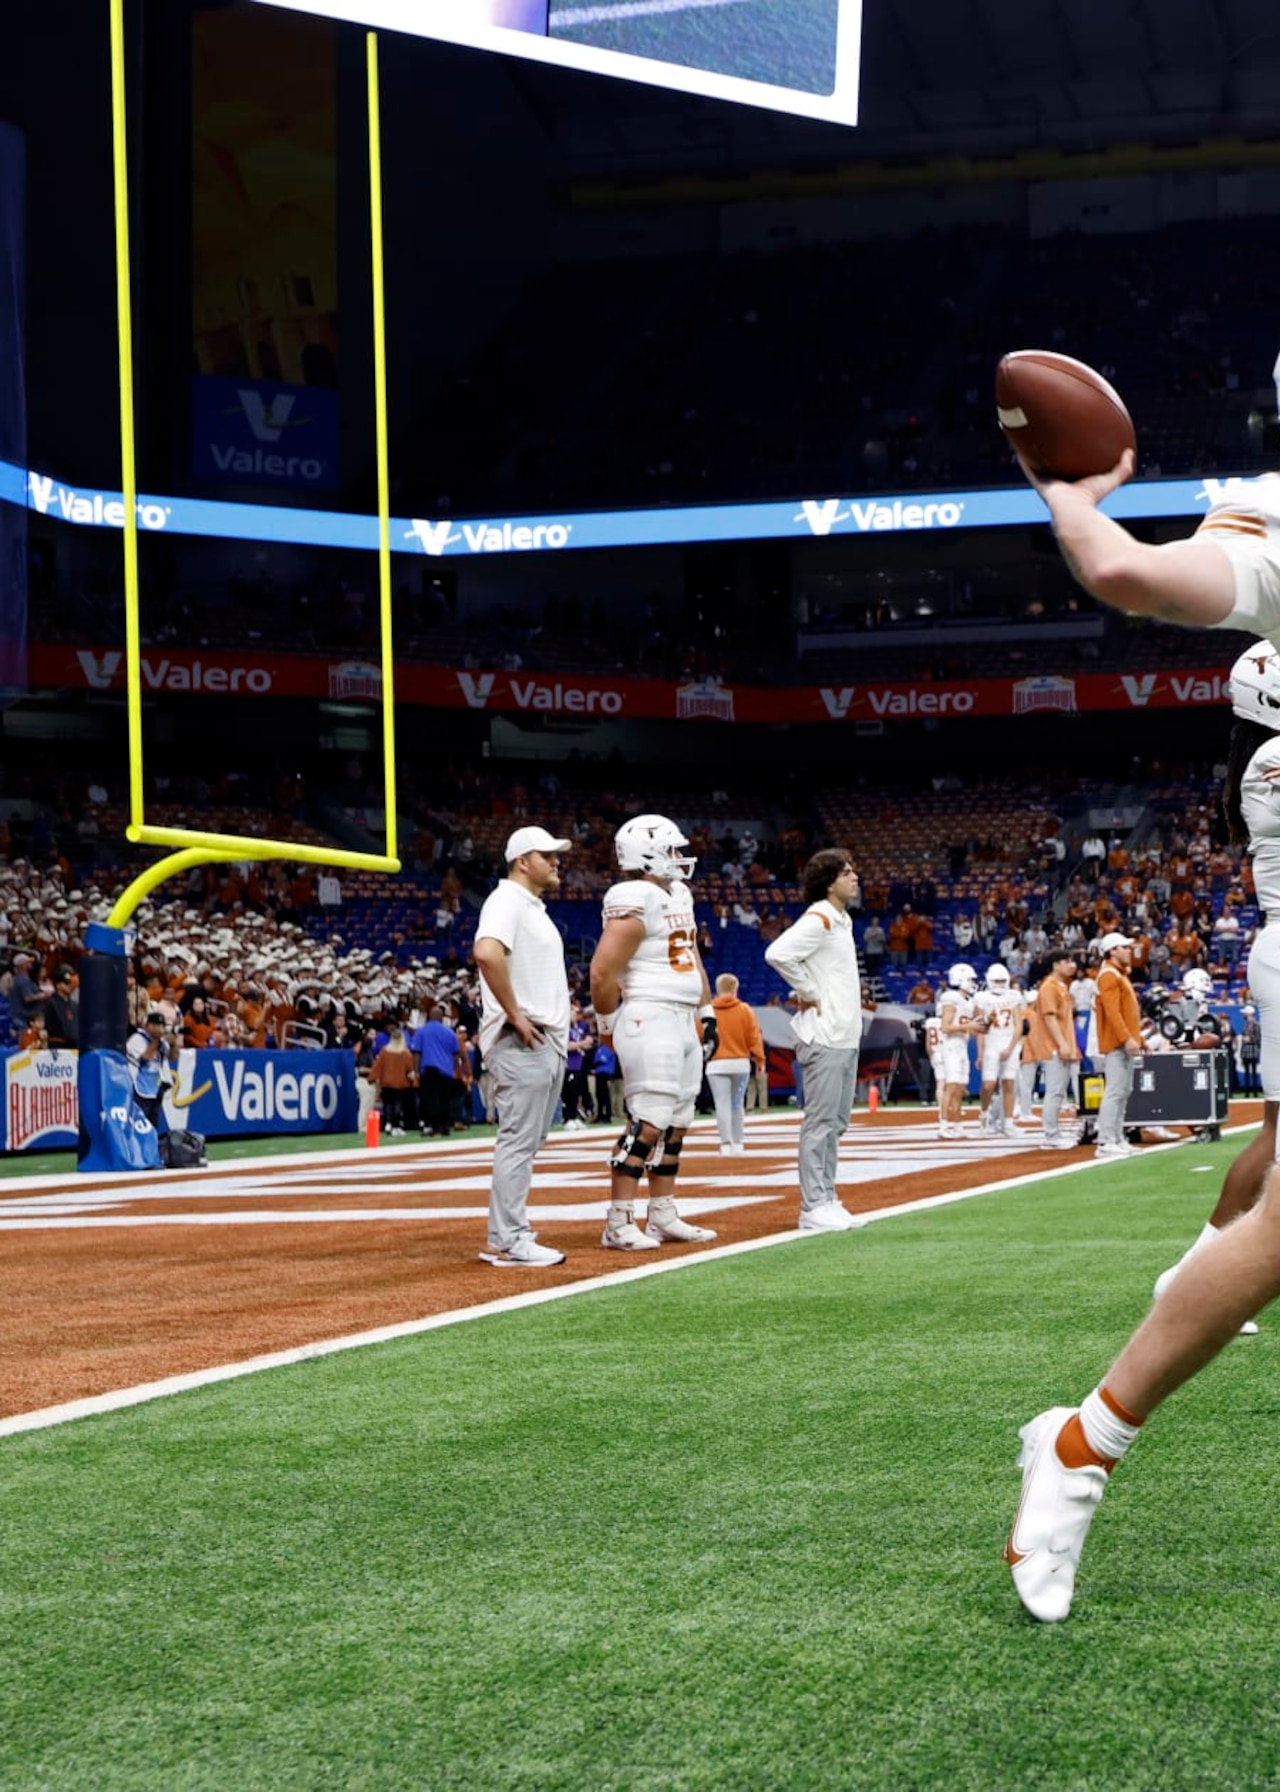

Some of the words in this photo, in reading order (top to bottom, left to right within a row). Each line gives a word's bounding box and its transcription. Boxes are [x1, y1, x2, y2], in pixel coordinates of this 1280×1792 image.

[211, 444, 321, 479] Valero
[58, 488, 166, 529] Valeo
[850, 502, 960, 530] Valero
[461, 523, 567, 551] Valero
[141, 659, 272, 692] Valero
[510, 681, 622, 712] Valero
[868, 689, 974, 715] Valero
[36, 1061, 73, 1079] Valero
[213, 1060, 339, 1121] Valero
